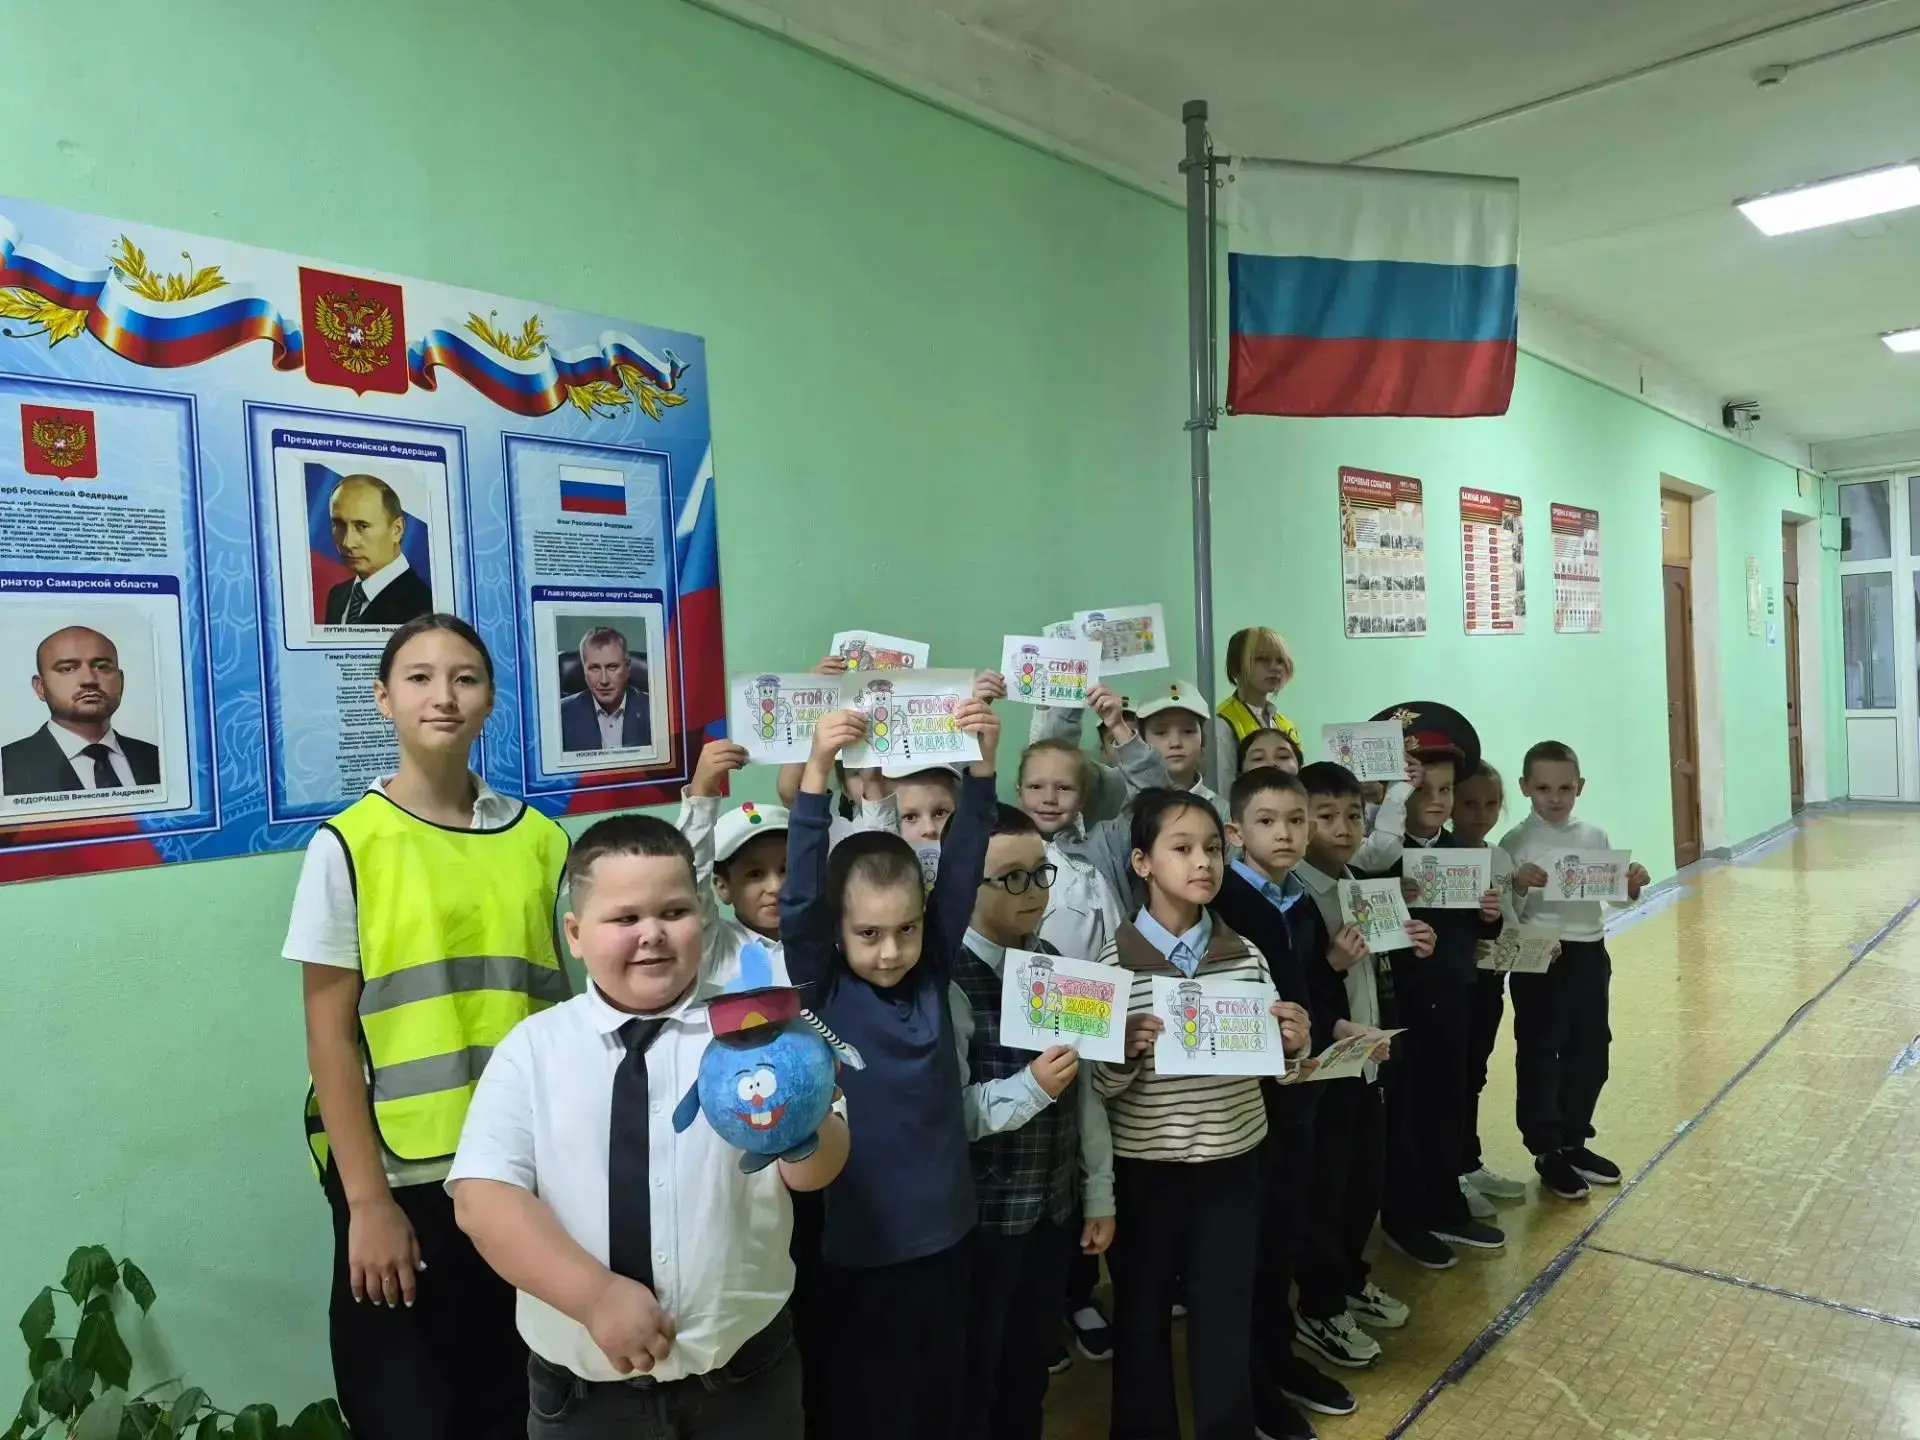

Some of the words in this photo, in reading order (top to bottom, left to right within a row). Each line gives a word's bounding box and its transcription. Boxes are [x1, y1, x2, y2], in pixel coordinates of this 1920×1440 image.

[283, 434, 333, 447] Президент
[335, 439, 388, 452] Российской
[390, 445, 438, 457] Федерации
[1, 487, 18, 495] ерб
[20, 487, 76, 498] Российской
[77, 490, 128, 501] Федерации
[1, 578, 43, 589] рнатор
[46, 577, 111, 589] Самарской
[113, 579, 159, 589] области
[543, 589, 564, 597] Глава
[565, 590, 604, 599] городского
[605, 591, 628, 600] округа
[628, 591, 653, 600] Самара
[348, 627, 380, 635] Владимир
[345, 652, 382, 660] Российско
[1049, 660, 1074, 672] СТОЙ
[792, 689, 822, 705] СТОЙ
[1050, 687, 1072, 698] ИДИ
[908, 696, 943, 714] СТОЙ
[912, 717, 944, 733] ЖДИ
[914, 735, 946, 752] ИДИ
[13, 794, 70, 805] ФЕДОРИЩЕВ
[71, 792, 110, 800] Вячеслав
[111, 788, 155, 798] Андреевич
[1064, 980, 1098, 998] СТОЙ
[1065, 998, 1097, 1014] ЖДИ
[1216, 998, 1250, 1014] СТОЙ
[1220, 1018, 1249, 1032] ЖДИ
[1221, 1035, 1249, 1050] ИДИ
